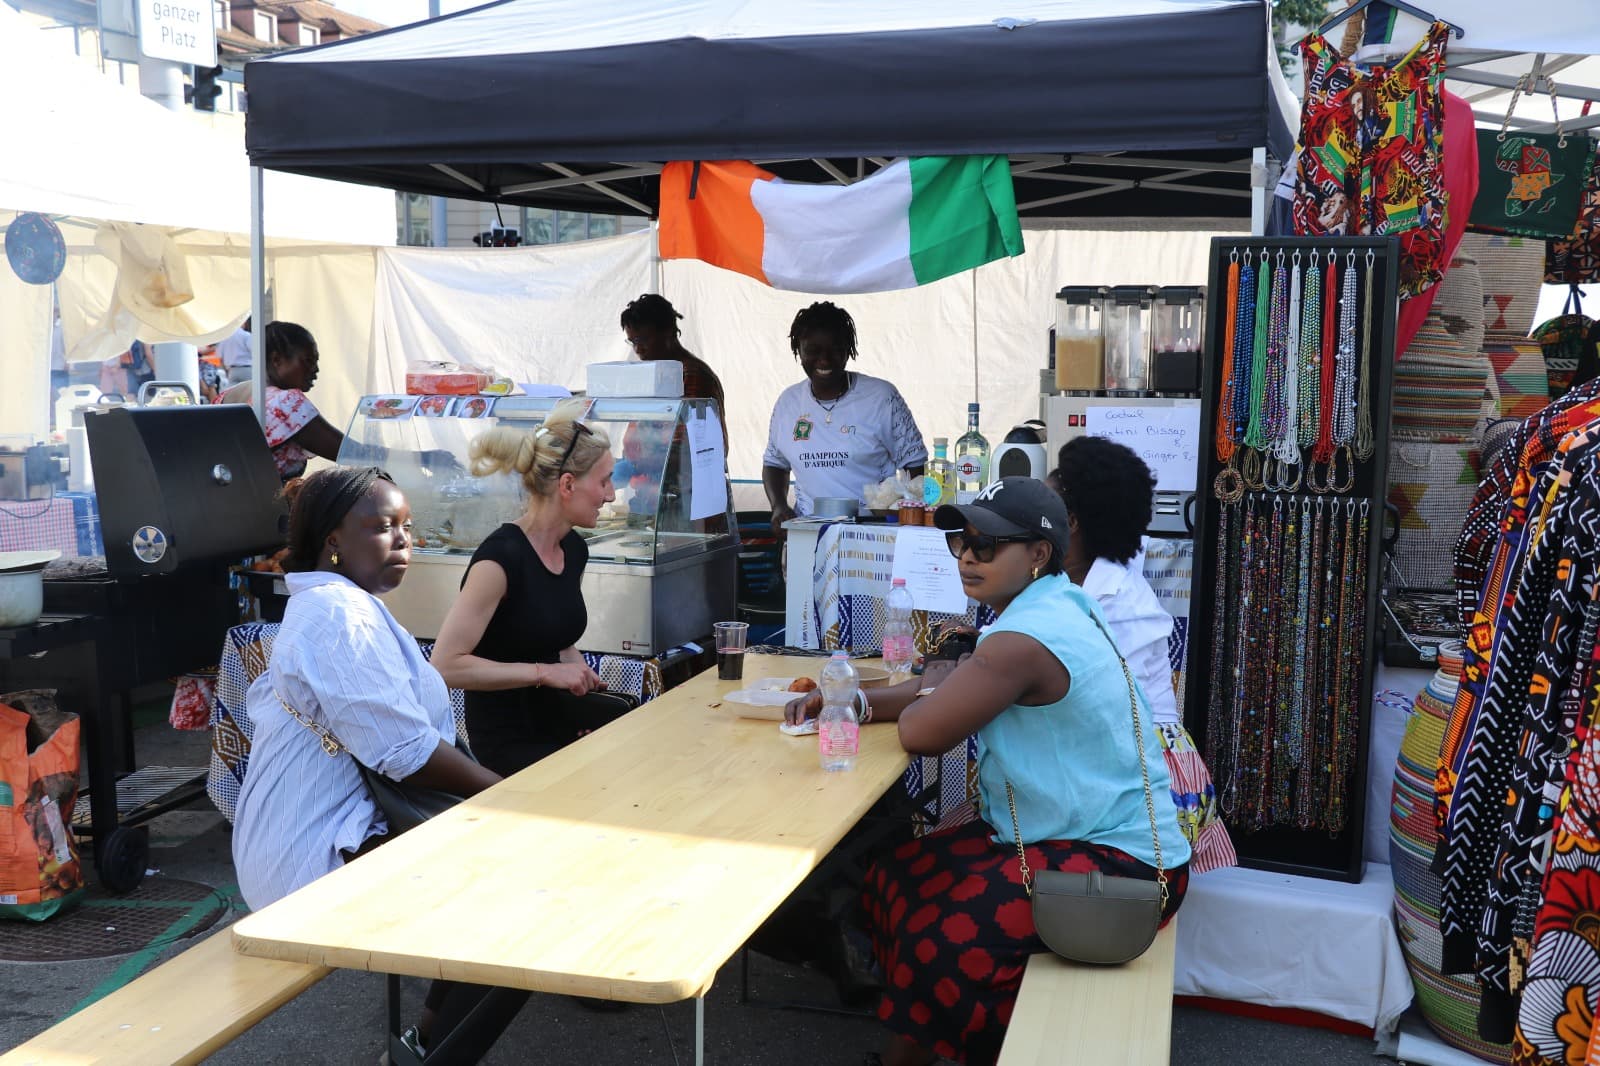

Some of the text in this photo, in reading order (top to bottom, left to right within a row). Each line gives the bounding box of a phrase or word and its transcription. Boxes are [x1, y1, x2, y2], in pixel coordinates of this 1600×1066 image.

[153, 2, 200, 23] ganzer
[161, 26, 196, 48] Platz
[799, 451, 849, 461] CHAMPIONS
[1142, 449, 1178, 463] Ginger
[804, 460, 846, 469] D'AFRIQUE
[956, 465, 981, 473] MARTINI
